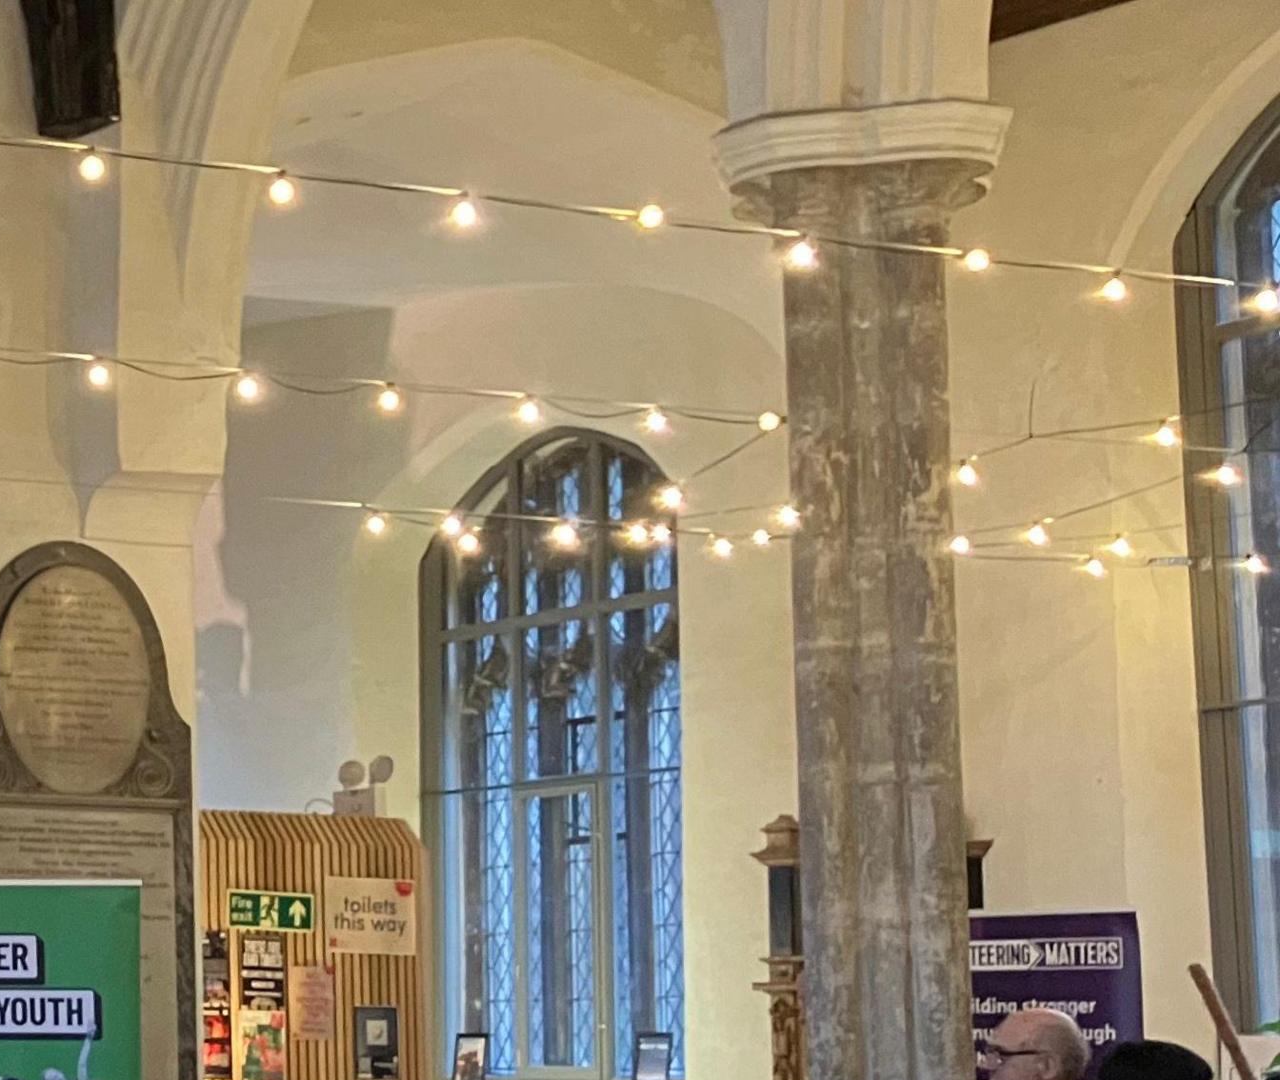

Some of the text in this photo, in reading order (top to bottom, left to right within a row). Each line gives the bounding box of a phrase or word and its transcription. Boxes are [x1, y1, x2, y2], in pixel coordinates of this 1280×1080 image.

[231, 895, 253, 908] Fire
[344, 897, 396, 914] toilets
[231, 911, 253, 922] exit
[334, 915, 408, 938] this way
[1044, 941, 1118, 966] MATTERS
